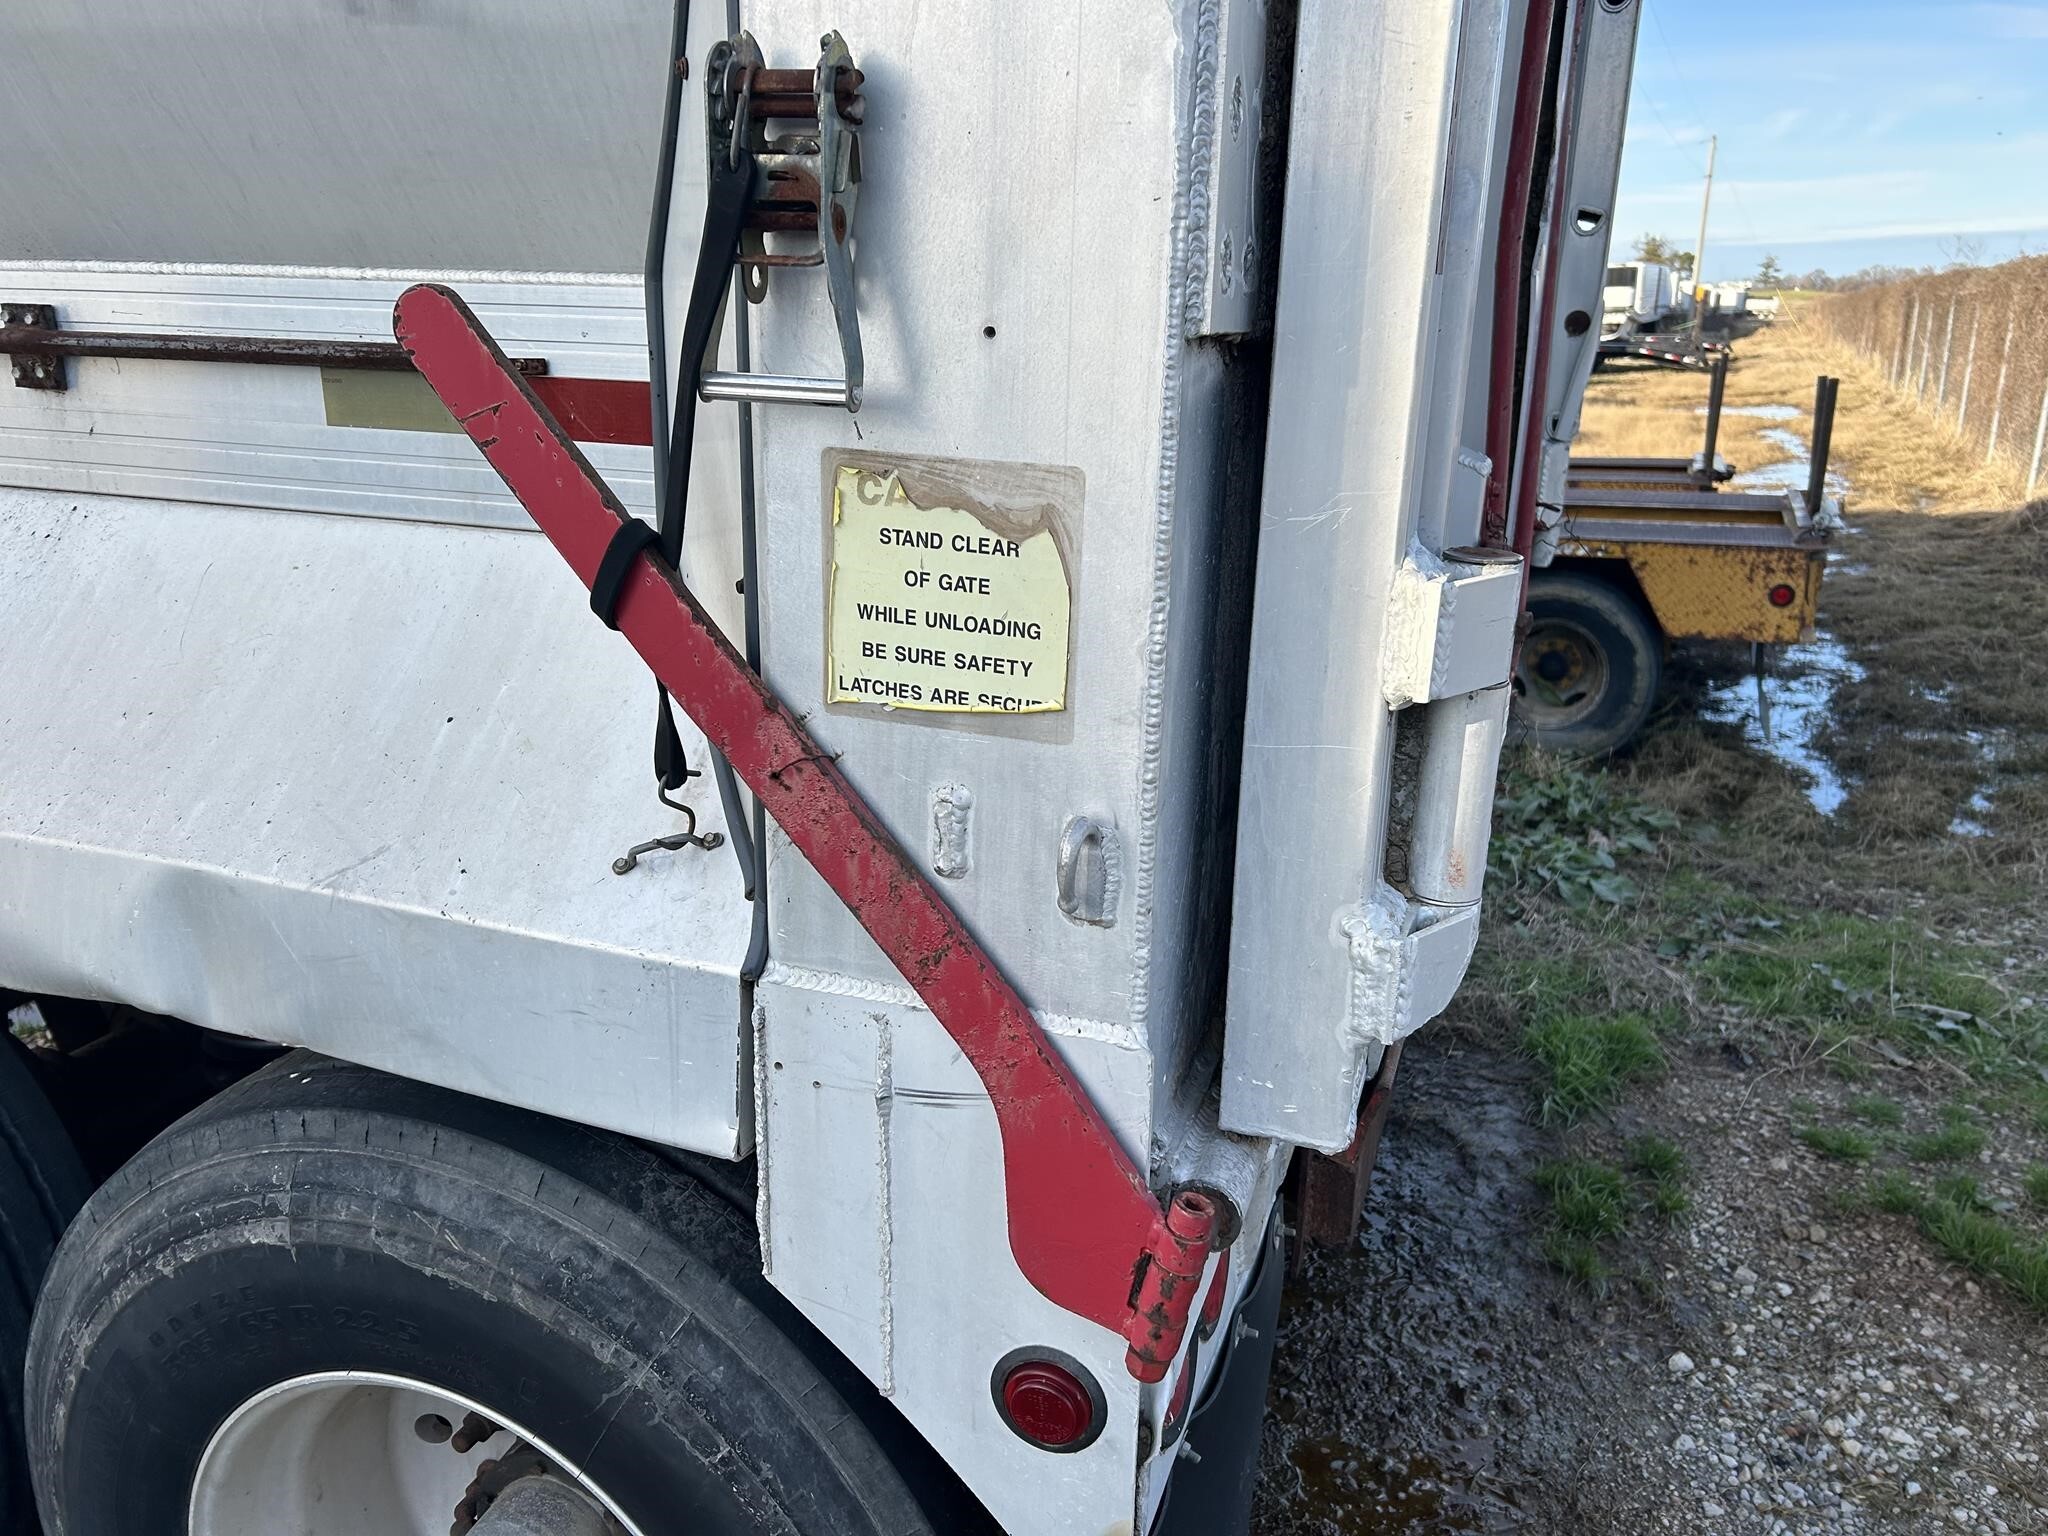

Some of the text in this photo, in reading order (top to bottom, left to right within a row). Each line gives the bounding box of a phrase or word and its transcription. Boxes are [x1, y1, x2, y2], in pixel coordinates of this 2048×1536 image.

[879, 527, 1020, 558] STAND CLEAR
[904, 570, 991, 596] OF GATE
[856, 603, 1042, 640] WHILE UNLOADING
[862, 641, 1034, 678] BE SURE SAFETY
[839, 675, 1043, 712] LATCHES ARE SECU
